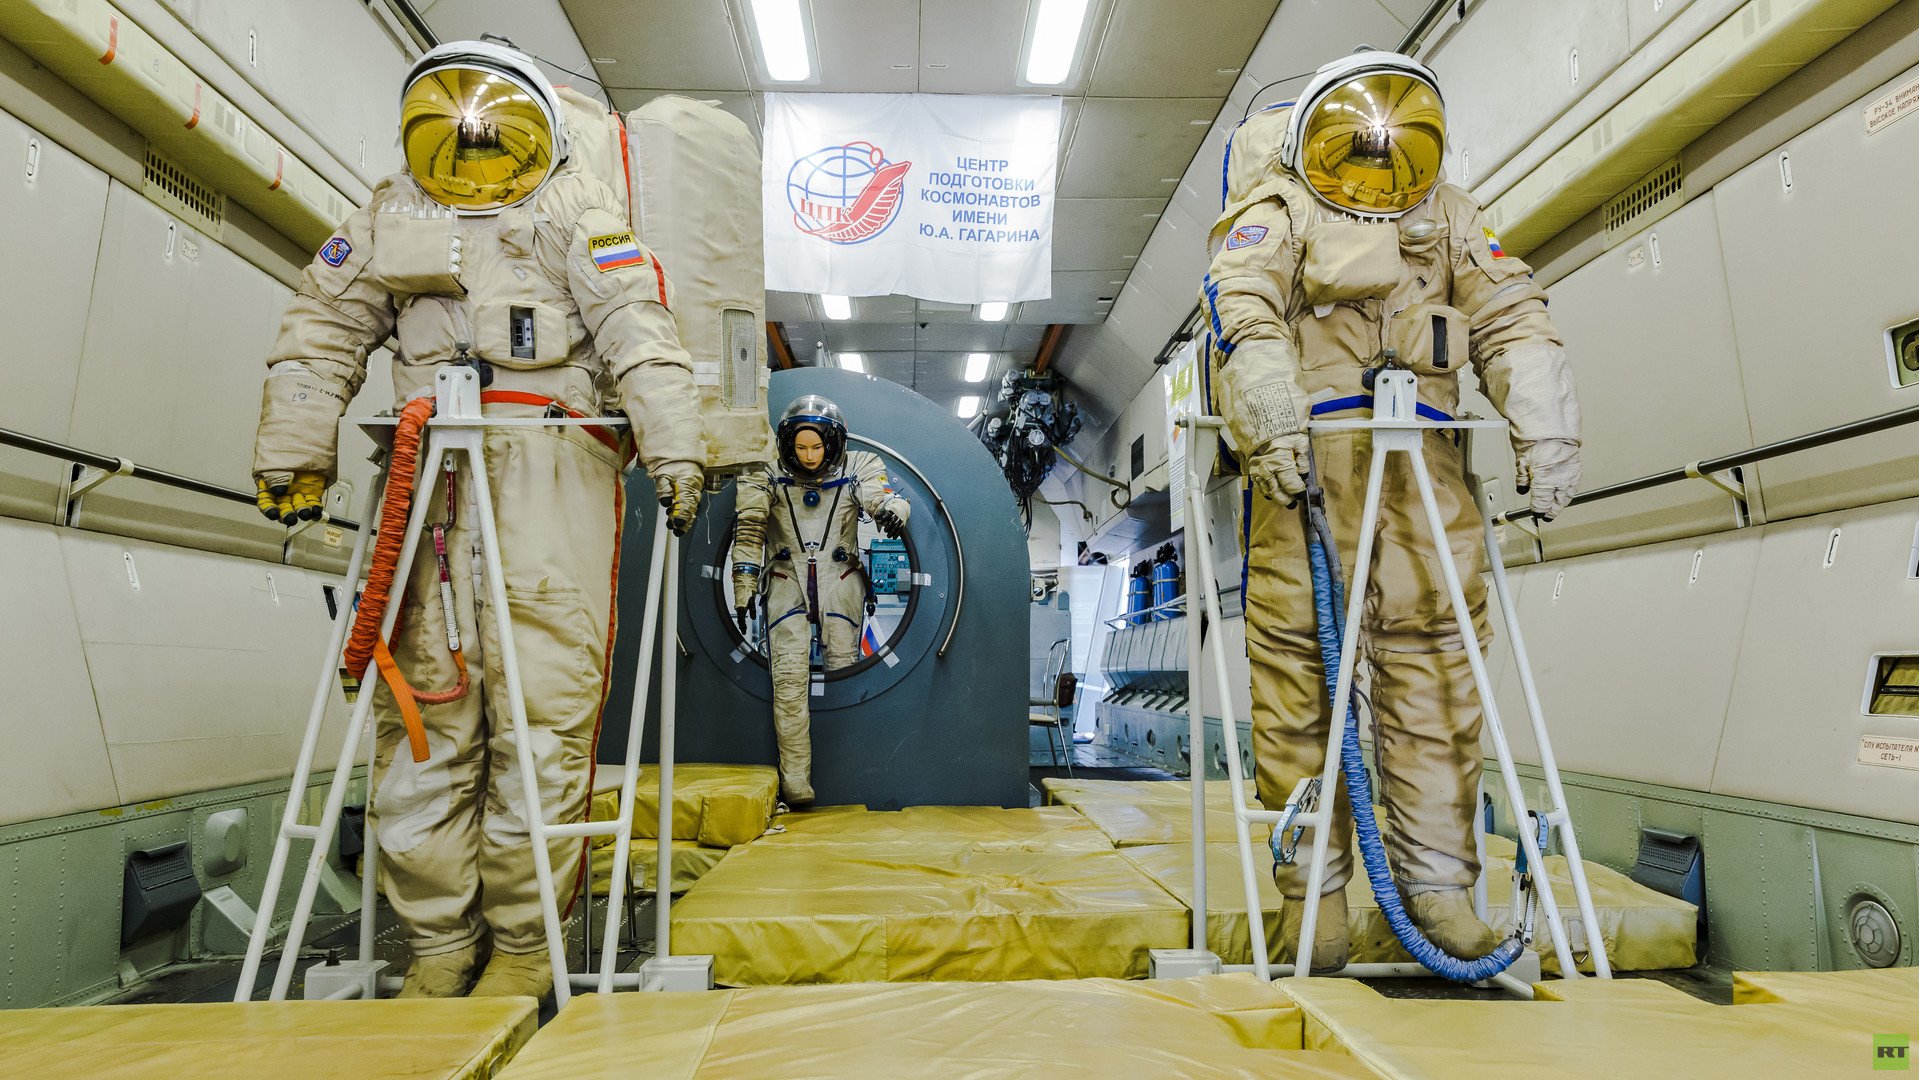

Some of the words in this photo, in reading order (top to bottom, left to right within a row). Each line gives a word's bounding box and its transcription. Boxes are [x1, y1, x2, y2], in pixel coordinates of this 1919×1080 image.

[1874, 99, 1893, 115] РУ-34
[1869, 107, 1896, 128] ВЫСОКОЕ
[957, 156, 1009, 172] ЦЕНТР
[929, 172, 1035, 191] ПОДГОТОВКИ
[921, 188, 1040, 208] КОСМОНАВТОВ
[800, 197, 853, 223] ЦПК
[952, 209, 1007, 225] ИМЕНИ
[919, 222, 953, 239] Ю.А.
[959, 228, 1040, 242] ГАГАРИНА
[592, 234, 631, 248] РОССИЯ
[1864, 741, 1875, 749] СПУ
[1876, 742, 1913, 752] ИСПЫТАТЕЛЯ
[1881, 752, 1902, 762] СЕТЬ-1
